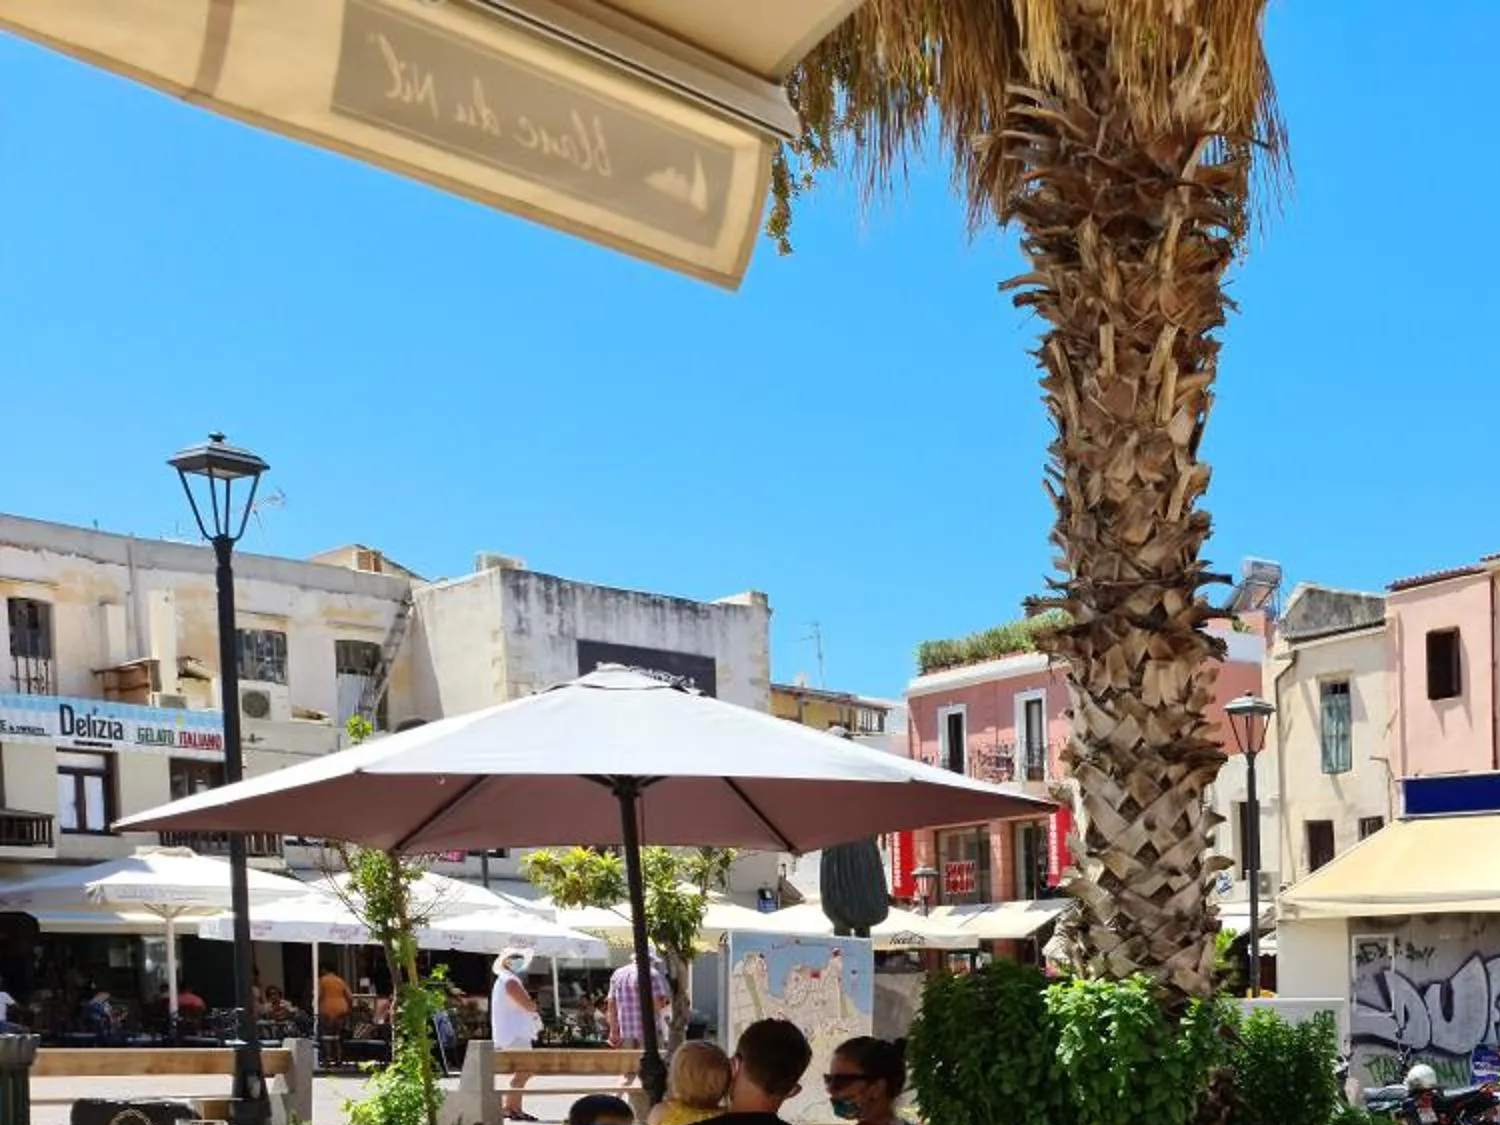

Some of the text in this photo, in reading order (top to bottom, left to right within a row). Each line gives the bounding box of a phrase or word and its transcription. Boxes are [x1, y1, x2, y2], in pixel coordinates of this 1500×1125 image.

[59, 703, 124, 740] Delizia
[136, 727, 222, 751] GELATO ITALIANO
